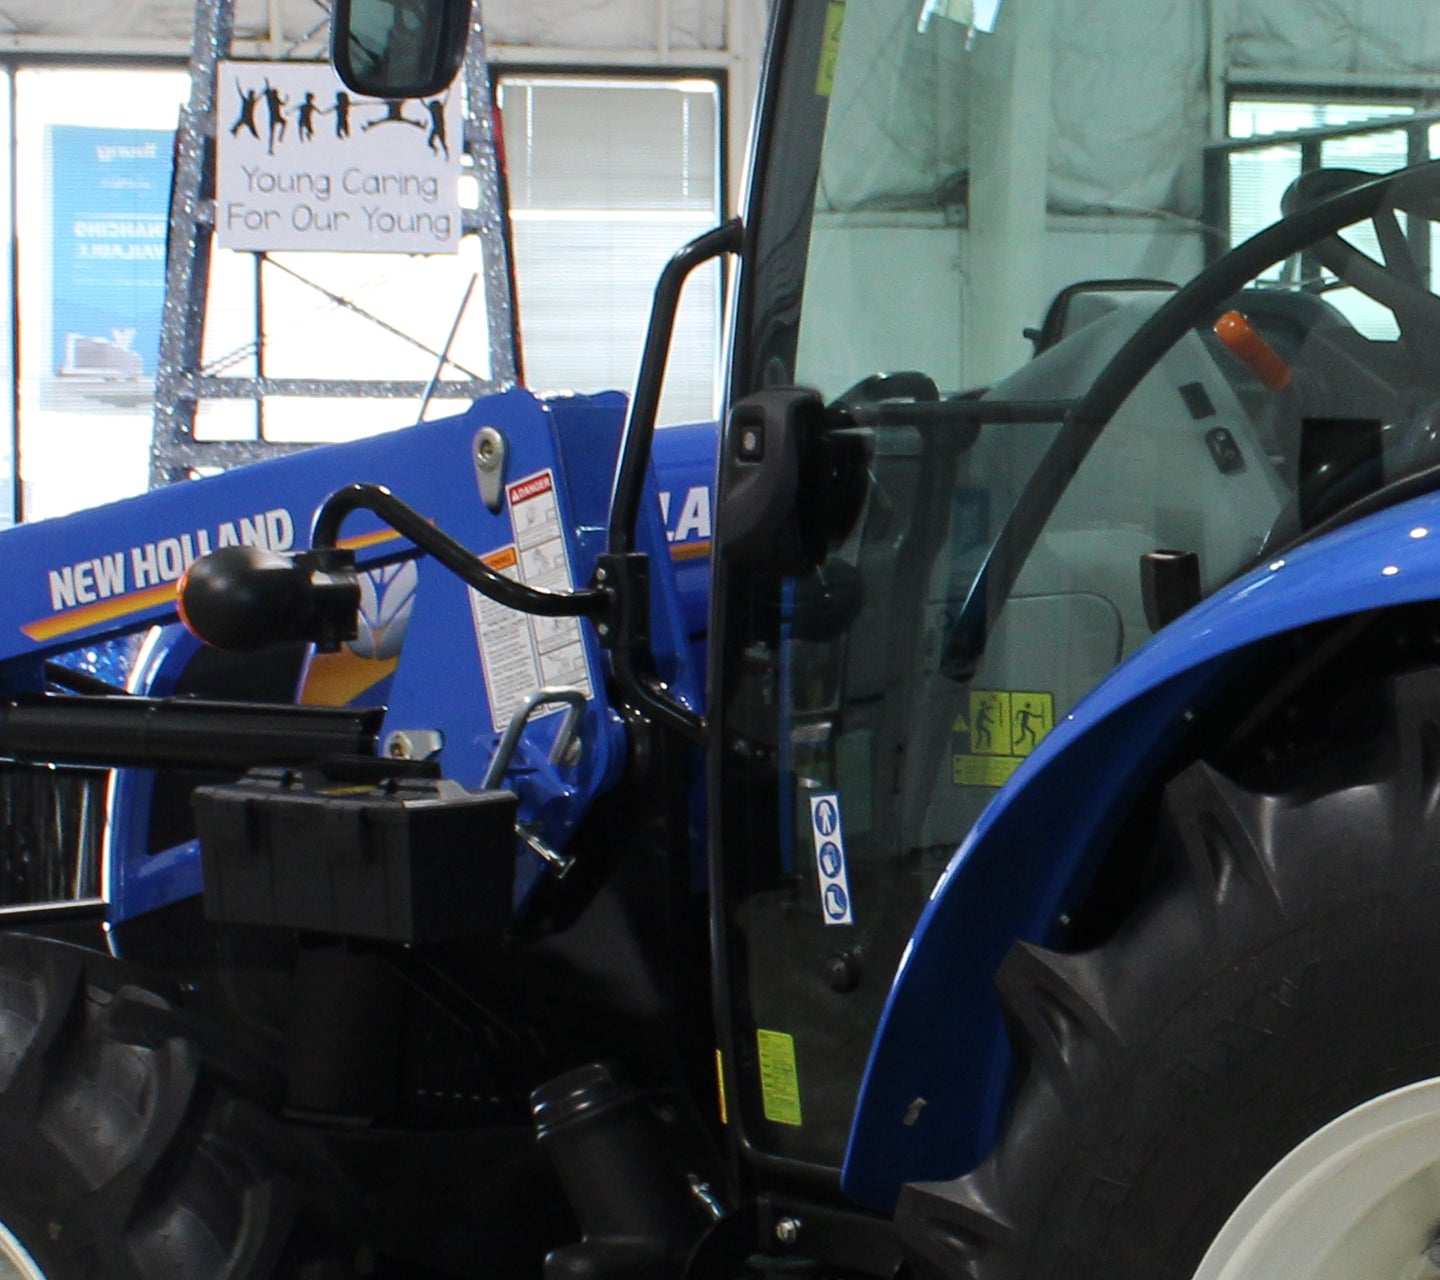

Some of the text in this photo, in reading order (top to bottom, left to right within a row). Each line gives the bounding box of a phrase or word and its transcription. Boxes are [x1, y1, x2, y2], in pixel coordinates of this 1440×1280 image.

[241, 164, 438, 203] Young Caring
[226, 203, 452, 242] For Our Young
[517, 476, 551, 499] DANGER
[48, 552, 126, 611] NEW
